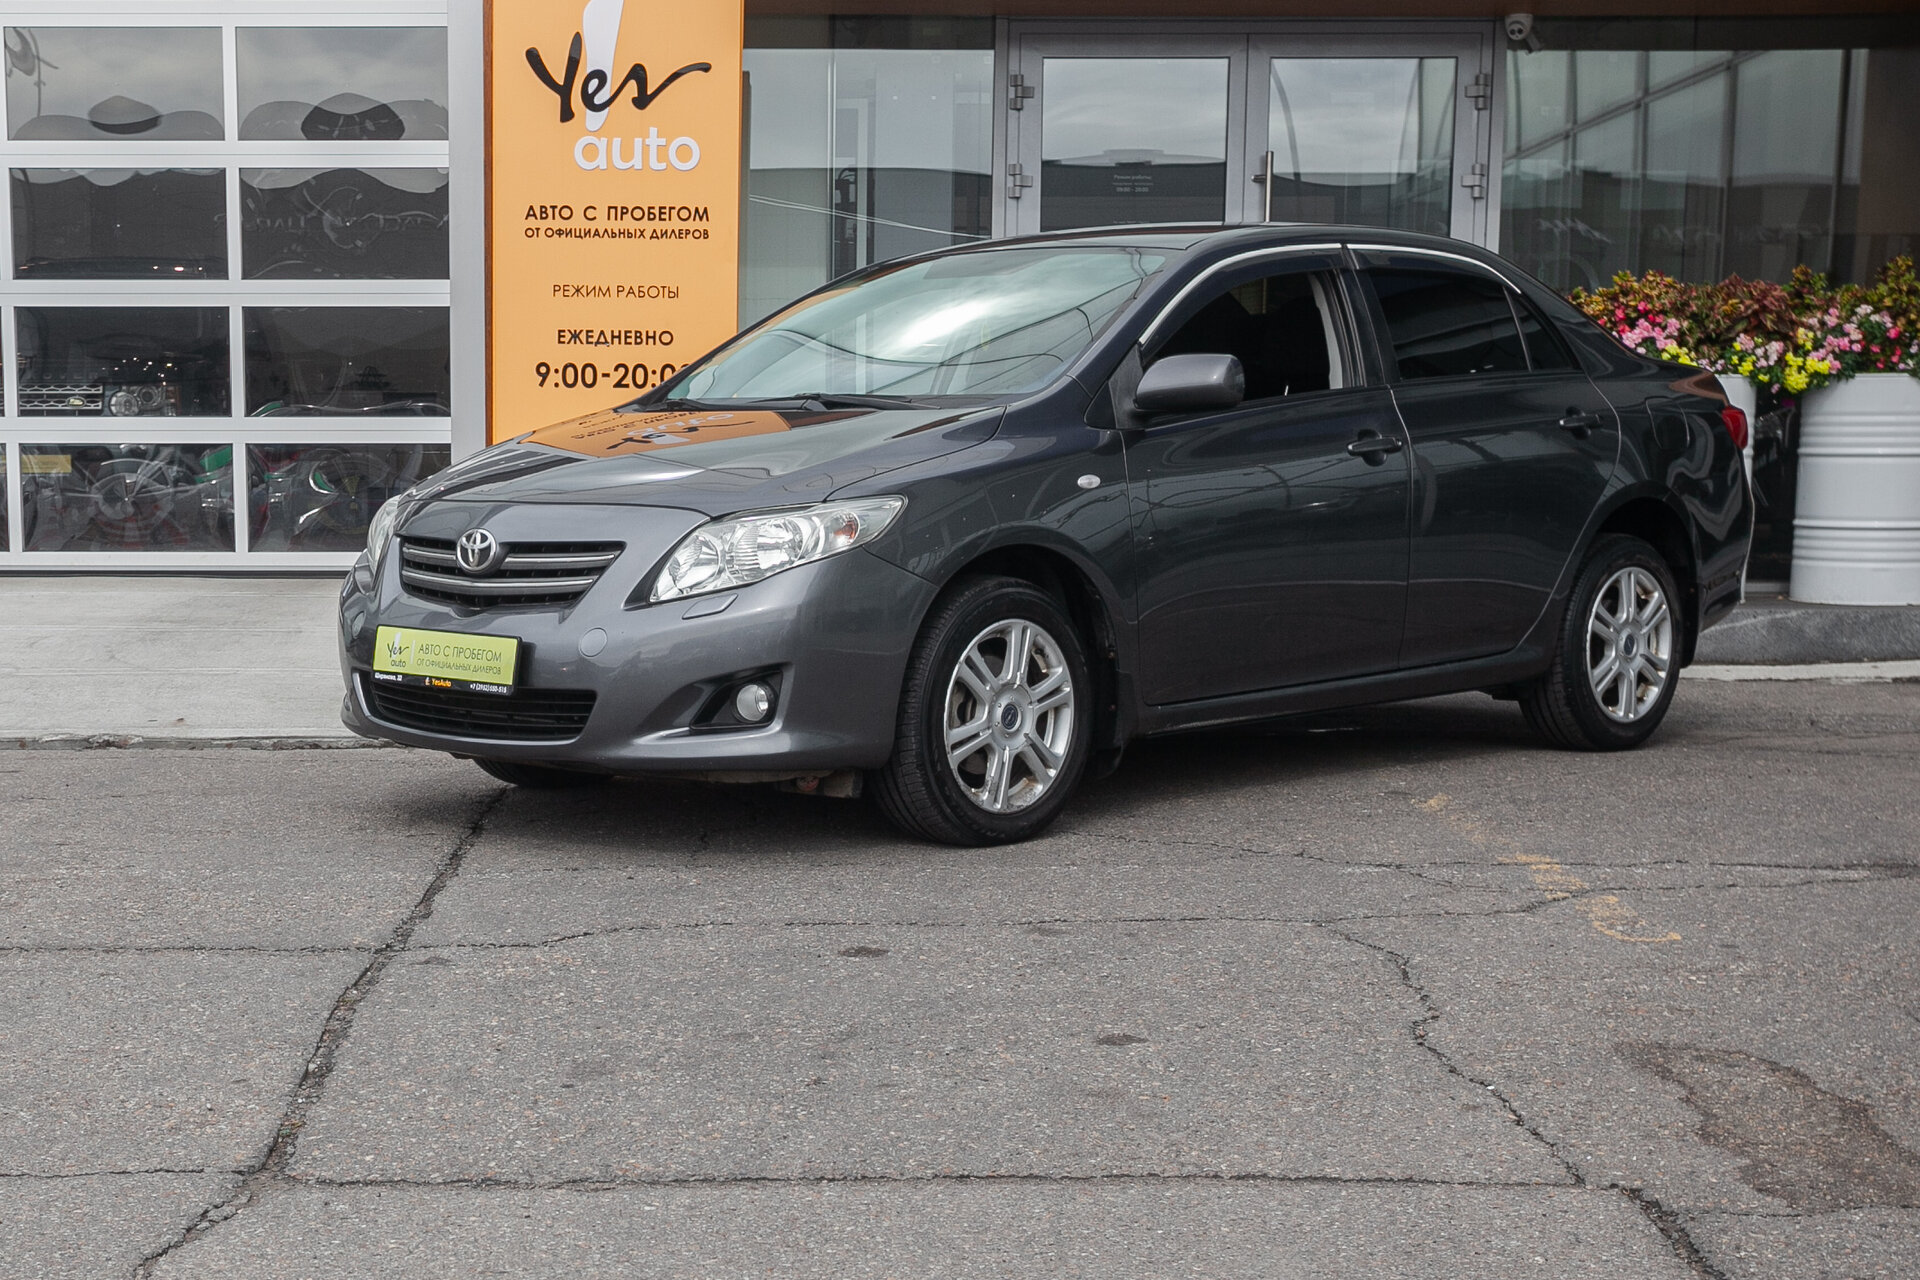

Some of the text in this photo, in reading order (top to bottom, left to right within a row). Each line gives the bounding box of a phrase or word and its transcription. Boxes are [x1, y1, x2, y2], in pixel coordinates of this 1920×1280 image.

[525, 31, 712, 123] Yes
[574, 127, 701, 171] auto
[524, 204, 710, 222] АВТО С ПРОБЕГОМ
[524, 227, 710, 241] ОТ ОФИЦИАЛЬНЫХ ДИЛЕРОВ
[552, 284, 679, 299] РЕЖИМ РАБОТЫ
[557, 328, 674, 347] ЕЖЕДНЕВНО
[535, 361, 690, 390] 9:00-20:0
[418, 643, 502, 663] АВТО С ПРОБЕГОМ
[390, 659, 407, 668] auto
[416, 659, 502, 675] ОТ ОФИЦИАЛЬНЫХ ДИЛЕРОВ
